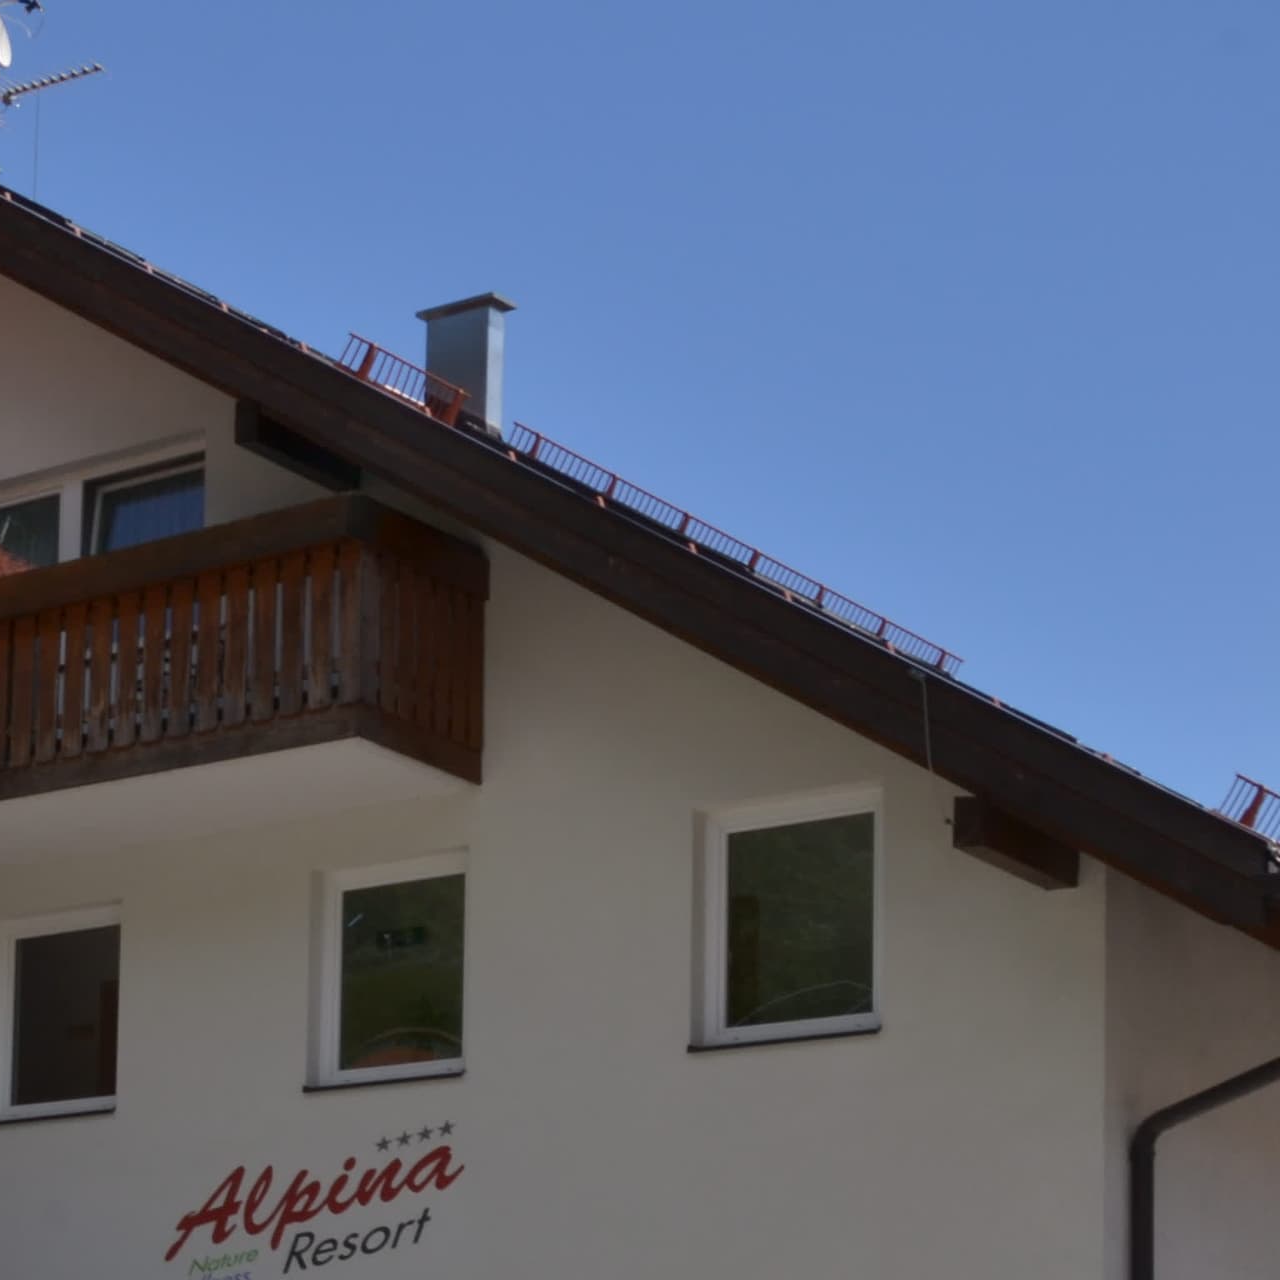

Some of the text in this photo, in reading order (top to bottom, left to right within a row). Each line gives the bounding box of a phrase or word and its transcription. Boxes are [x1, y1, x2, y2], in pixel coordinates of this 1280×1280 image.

[164, 1145, 465, 1262] Alpina
[188, 1248, 259, 1276] Nature
[283, 1208, 432, 1274] Resort
